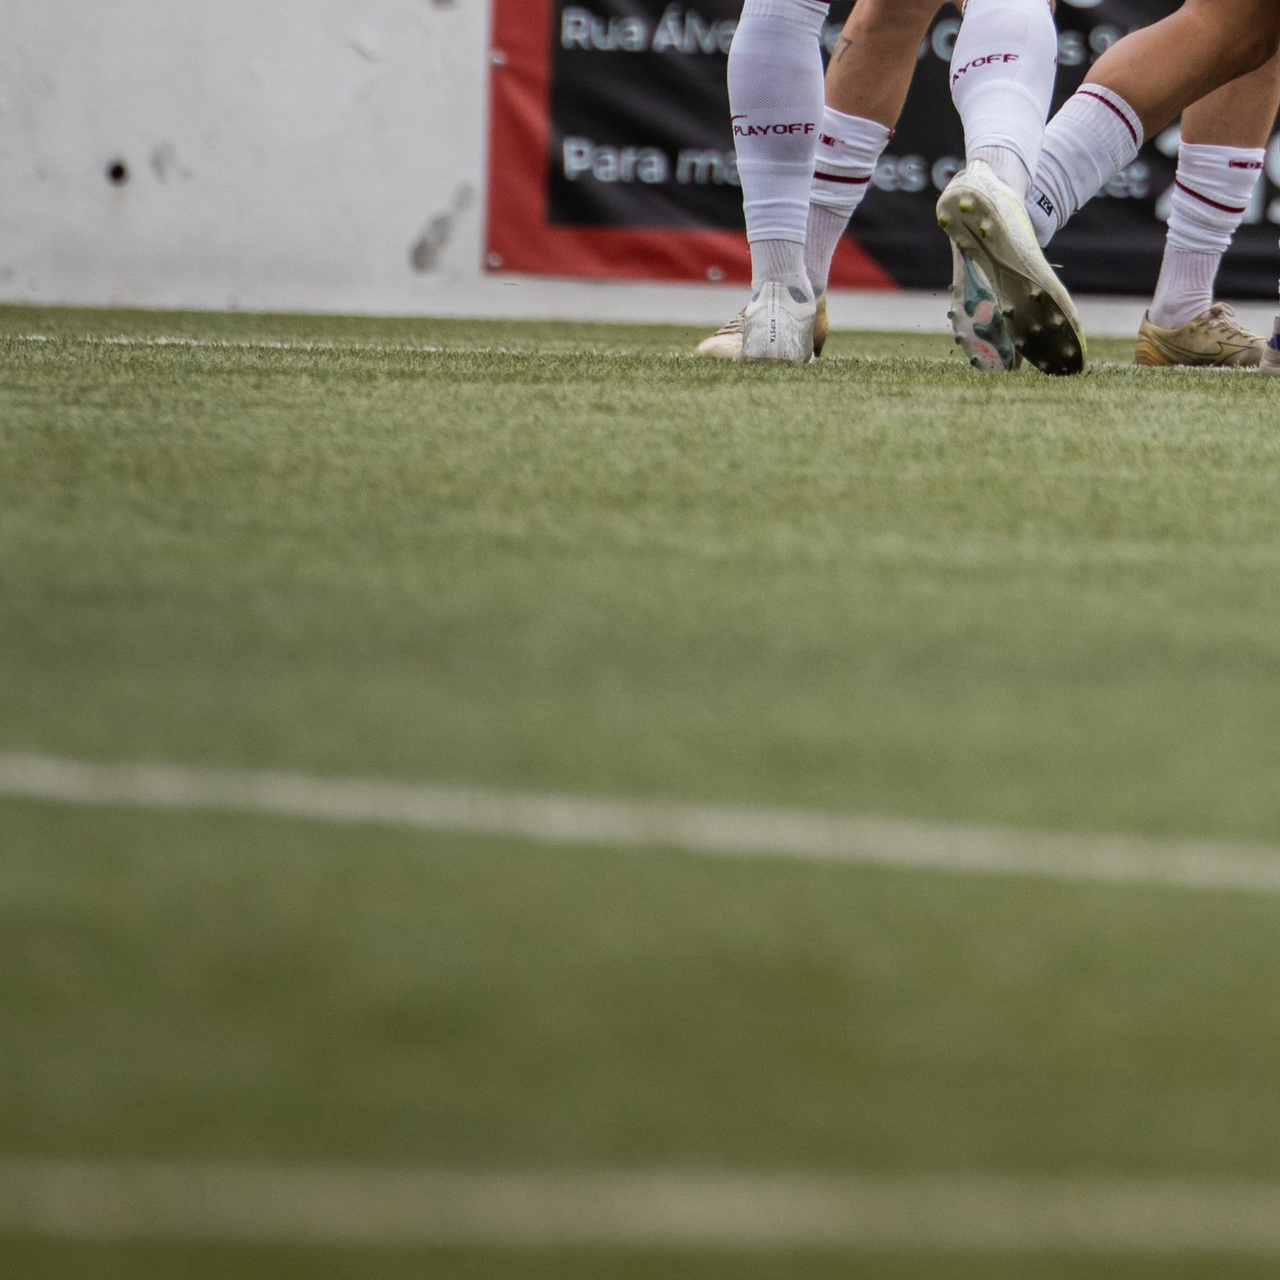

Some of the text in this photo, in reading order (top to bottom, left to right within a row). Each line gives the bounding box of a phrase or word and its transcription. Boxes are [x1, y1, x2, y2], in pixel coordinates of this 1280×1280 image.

[561, 6, 648, 52] Rua
[734, 123, 815, 136] PLAYOFF
[562, 137, 670, 185] Para
